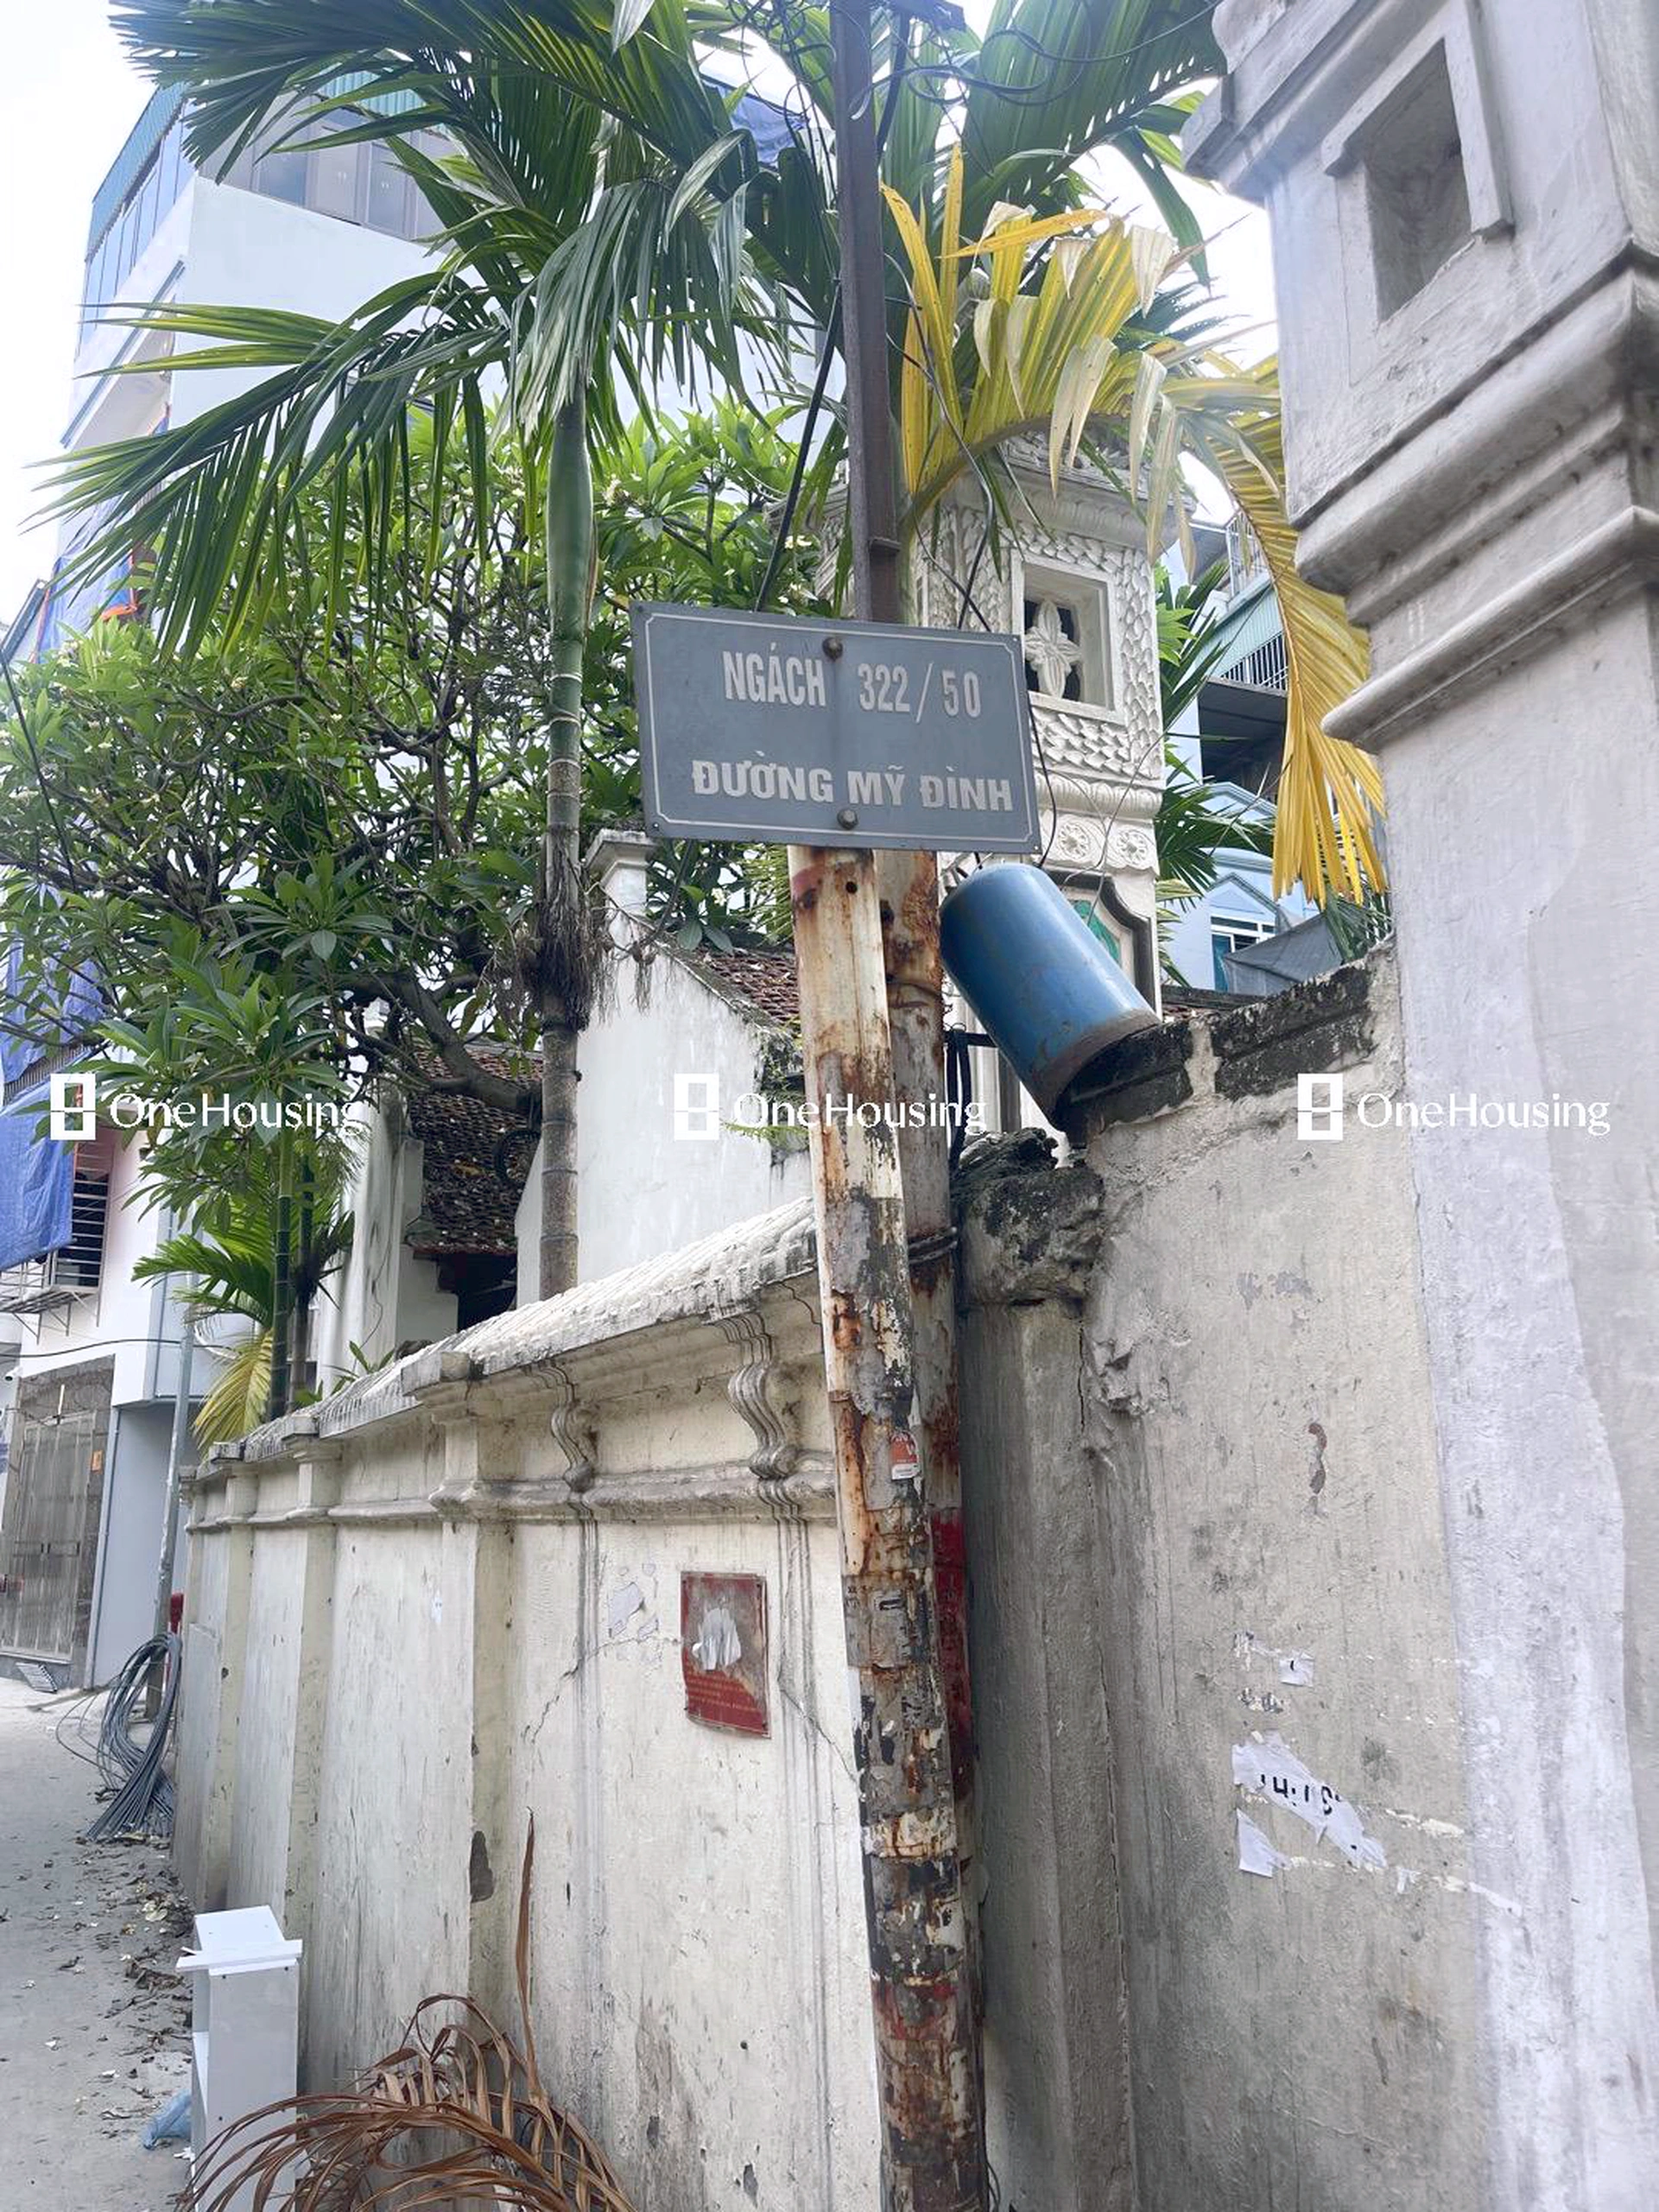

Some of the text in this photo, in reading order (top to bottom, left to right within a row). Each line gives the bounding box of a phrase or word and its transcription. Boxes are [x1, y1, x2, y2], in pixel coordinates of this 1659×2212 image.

[723, 643, 981, 724] NGÁCH 322/50
[692, 750, 1013, 812] ĐƯỜNG MỸ ĐÌNH
